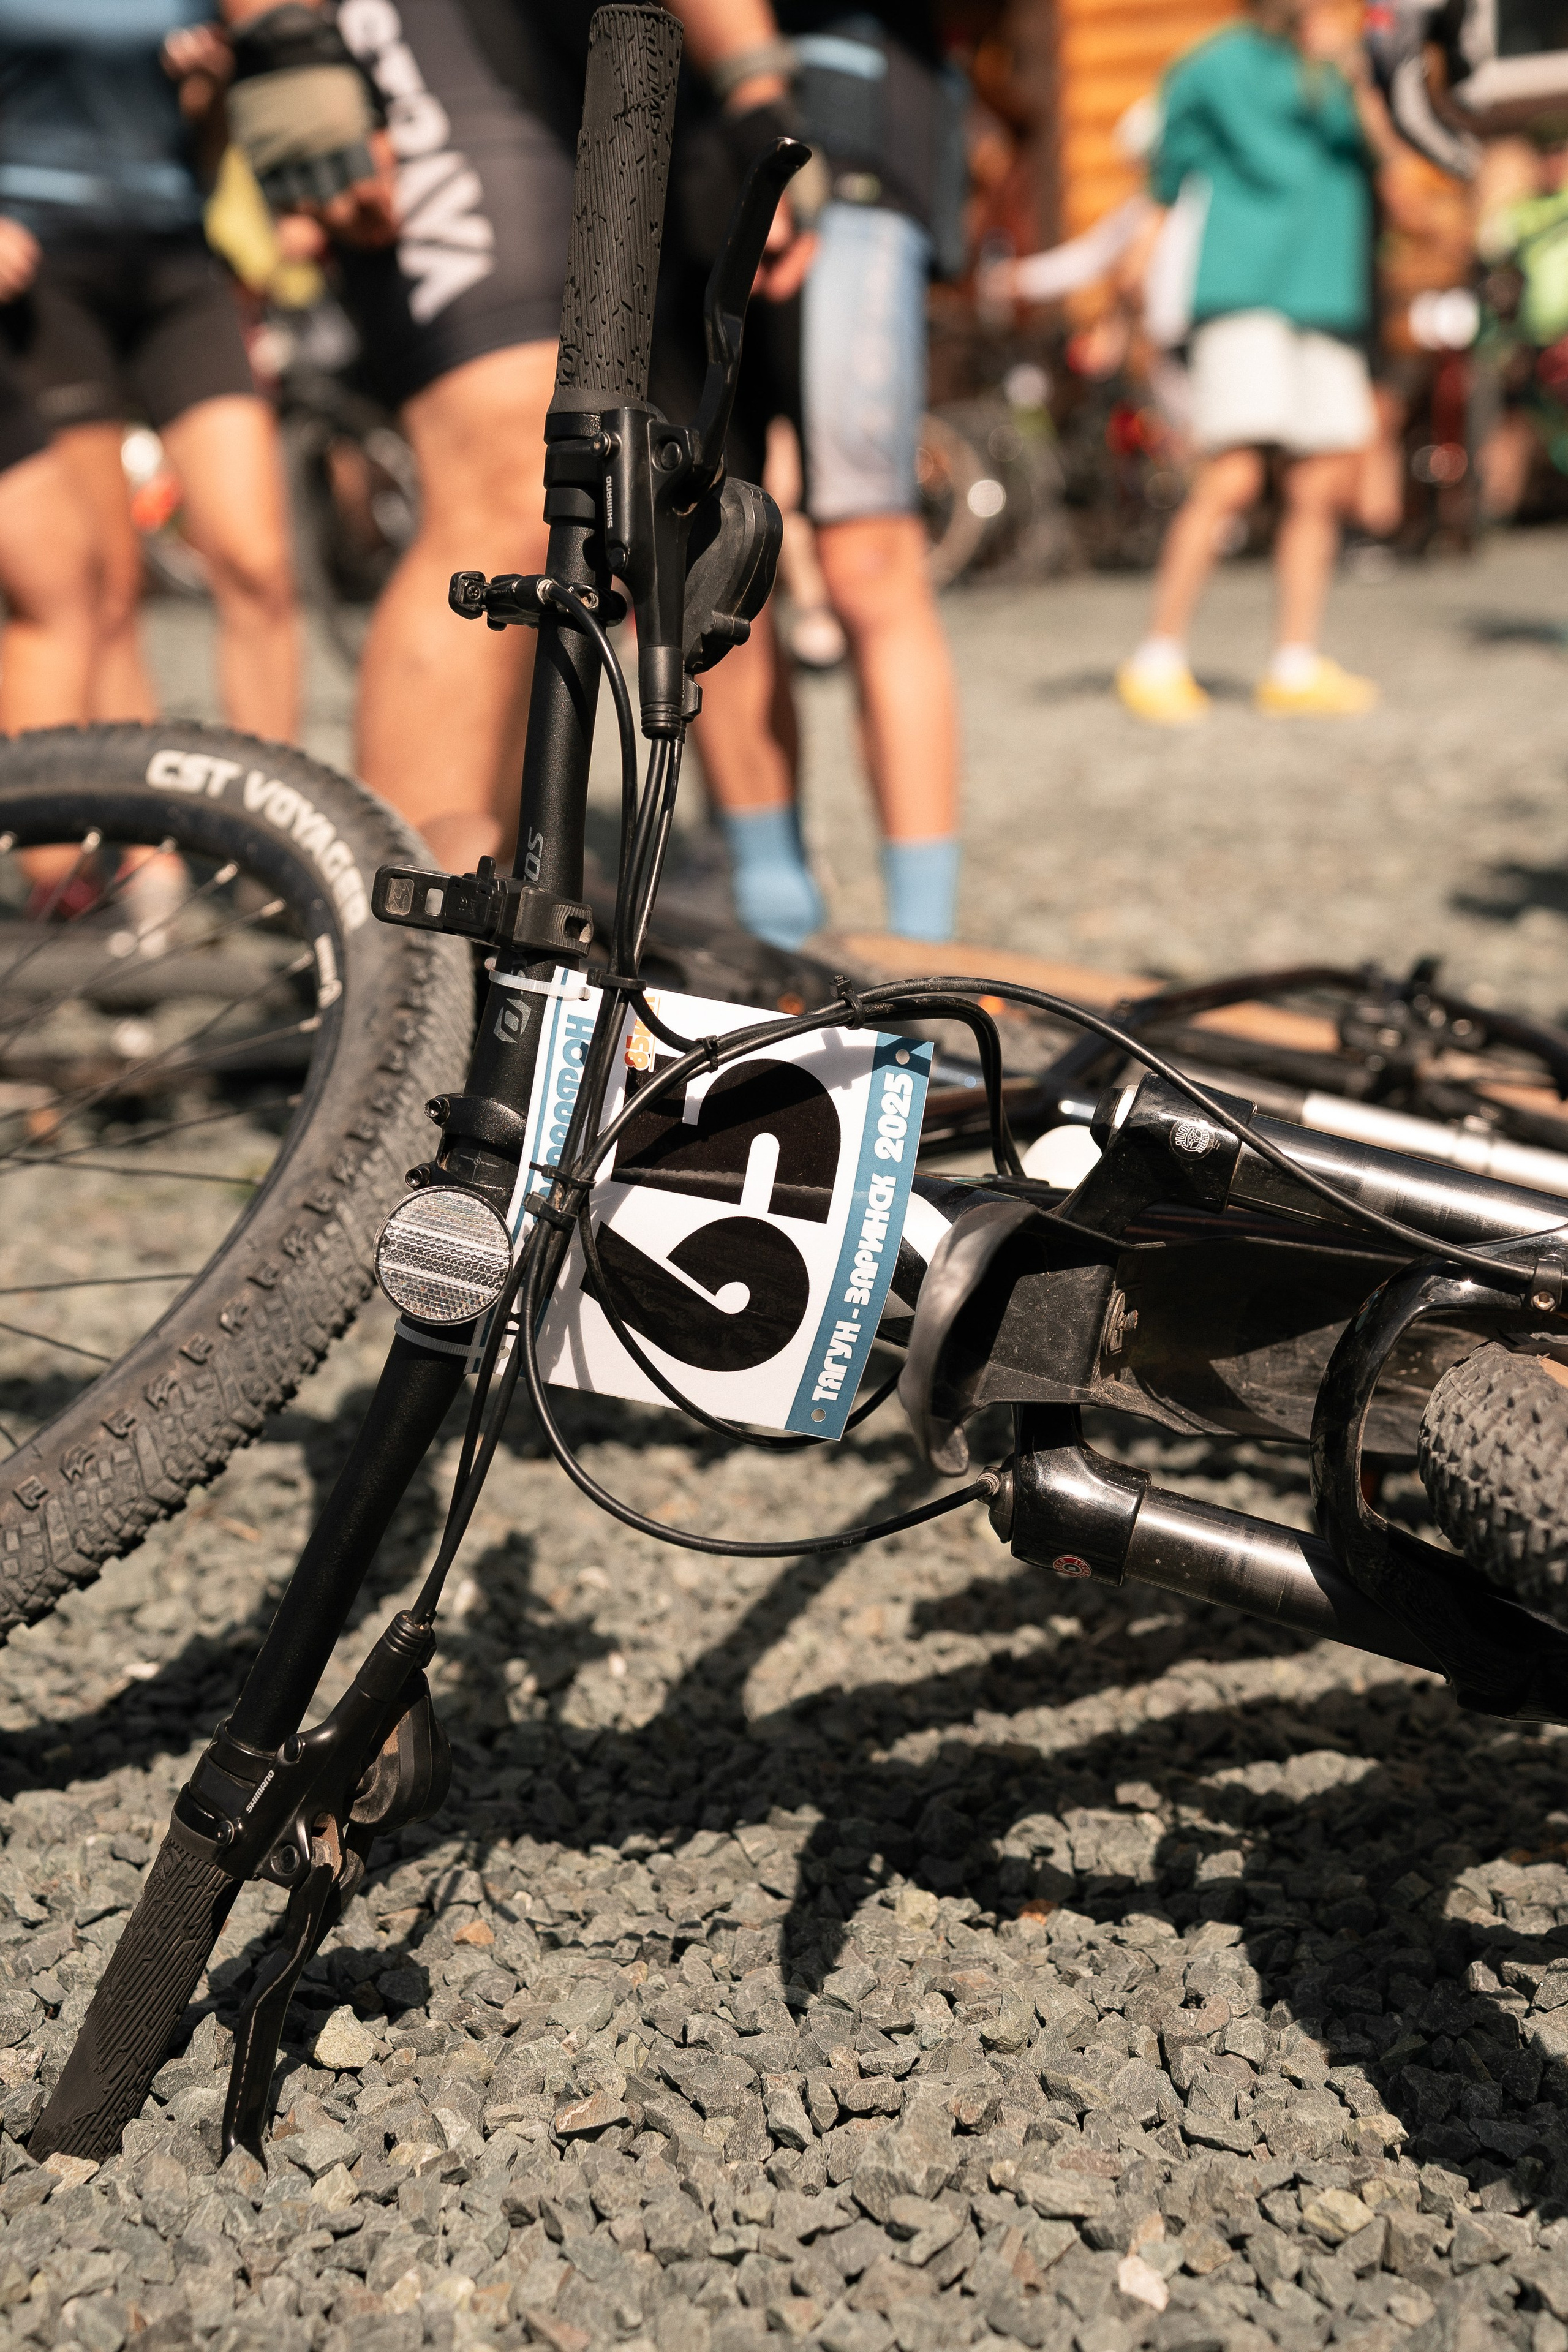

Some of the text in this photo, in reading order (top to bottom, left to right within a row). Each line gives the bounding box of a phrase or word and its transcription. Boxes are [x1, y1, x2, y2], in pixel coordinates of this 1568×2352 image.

[145, 749, 243, 797] CST
[1175, 1123, 1190, 1145] ALLOY
[579, 1054, 841, 1372] 65
[812, 1320, 861, 1401] ТЯГУН
[843, 1172, 897, 1306] ЗАРИНСК
[874, 1072, 914, 1163] 2025
[246, 1769, 275, 1814] SHIMANO
